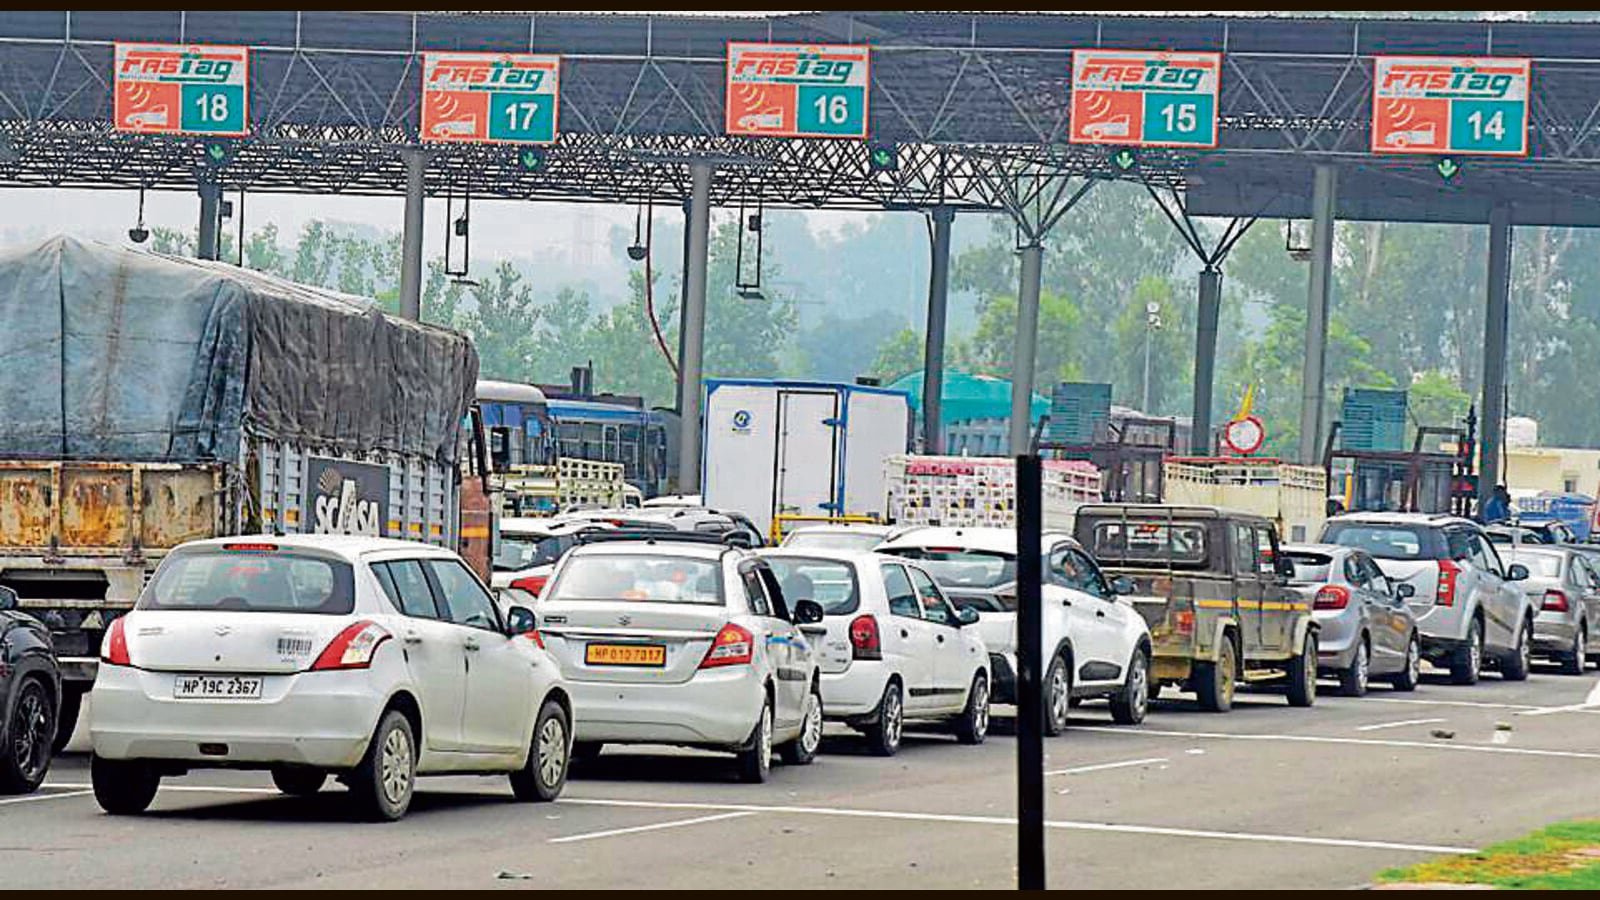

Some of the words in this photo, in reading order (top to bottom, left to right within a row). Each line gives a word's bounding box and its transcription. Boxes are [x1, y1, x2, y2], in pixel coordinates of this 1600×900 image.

[122, 51, 242, 82] FASTag
[430, 60, 554, 91] FASTag
[735, 52, 864, 83] FASTag
[1079, 58, 1214, 91] FASTag
[1383, 65, 1524, 98] FASTag
[196, 92, 229, 121] 18
[505, 102, 538, 130] 17
[814, 94, 848, 124] 16
[1161, 103, 1197, 132] 15
[1467, 110, 1506, 141] 14
[183, 679, 199, 693] HP
[227, 680, 259, 695] 2367
